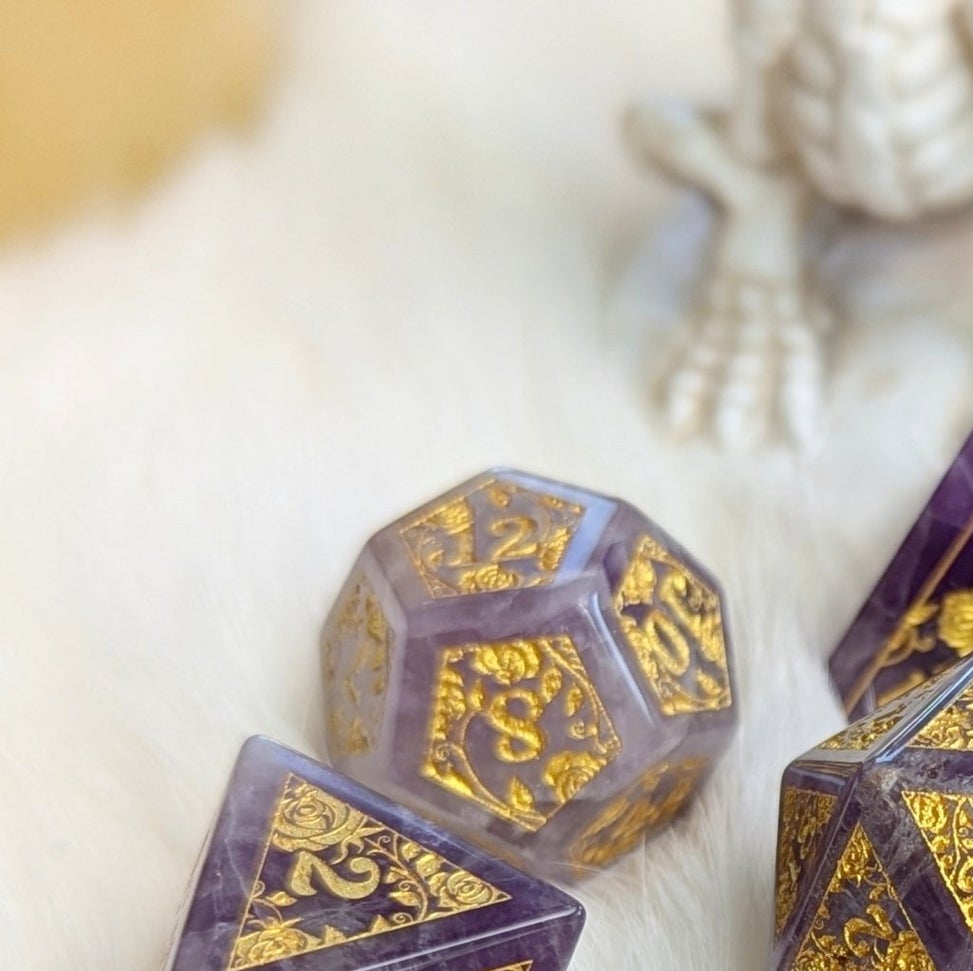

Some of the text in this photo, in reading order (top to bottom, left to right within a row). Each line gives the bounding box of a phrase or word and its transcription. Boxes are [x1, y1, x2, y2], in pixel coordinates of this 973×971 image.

[451, 502, 538, 567] 12
[488, 689, 544, 762] 8
[290, 850, 380, 901] 2
[843, 903, 896, 957] 2
